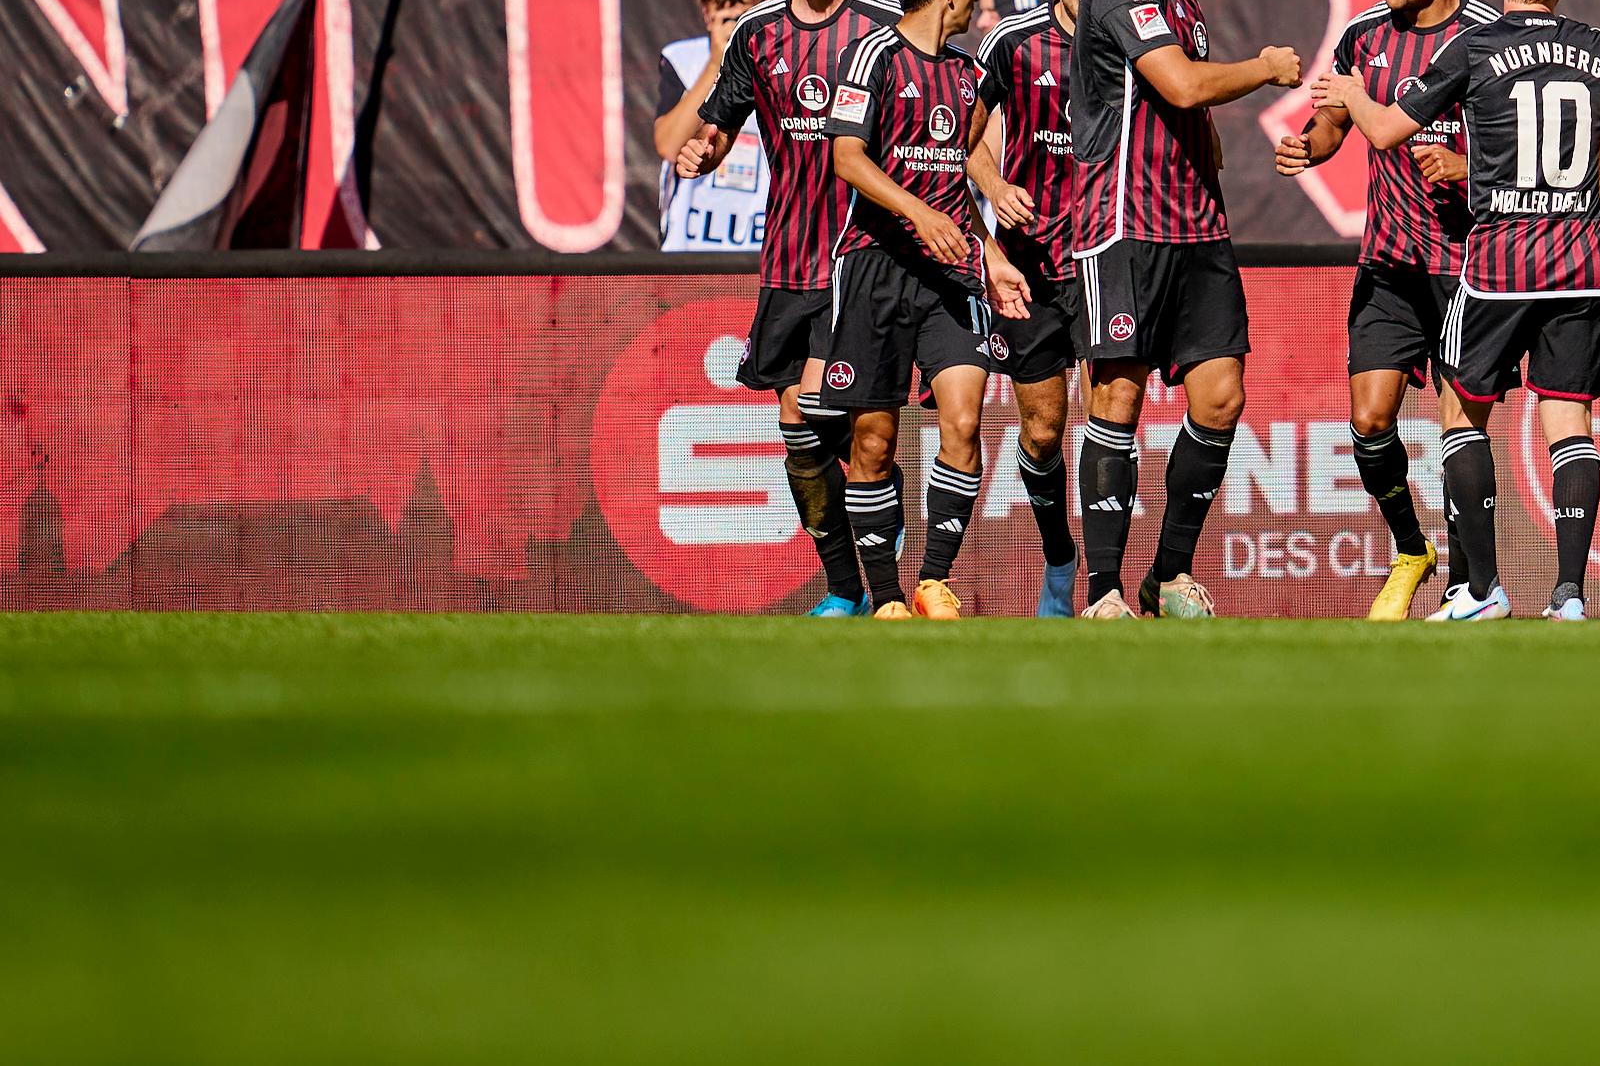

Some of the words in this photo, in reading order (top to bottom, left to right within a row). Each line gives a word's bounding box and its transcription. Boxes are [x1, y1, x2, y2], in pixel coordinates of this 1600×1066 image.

[1509, 80, 1593, 189] 10
[892, 144, 969, 162] NÜRNBERG
[904, 160, 963, 173] VERSCHERUNG
[1489, 189, 1549, 214] MØLLER
[1111, 324, 1133, 335] FCN
[920, 419, 1445, 516] ATNER
[1553, 507, 1585, 519] CLUB
[1224, 530, 1318, 580] DES
[1329, 529, 1450, 580] CL
